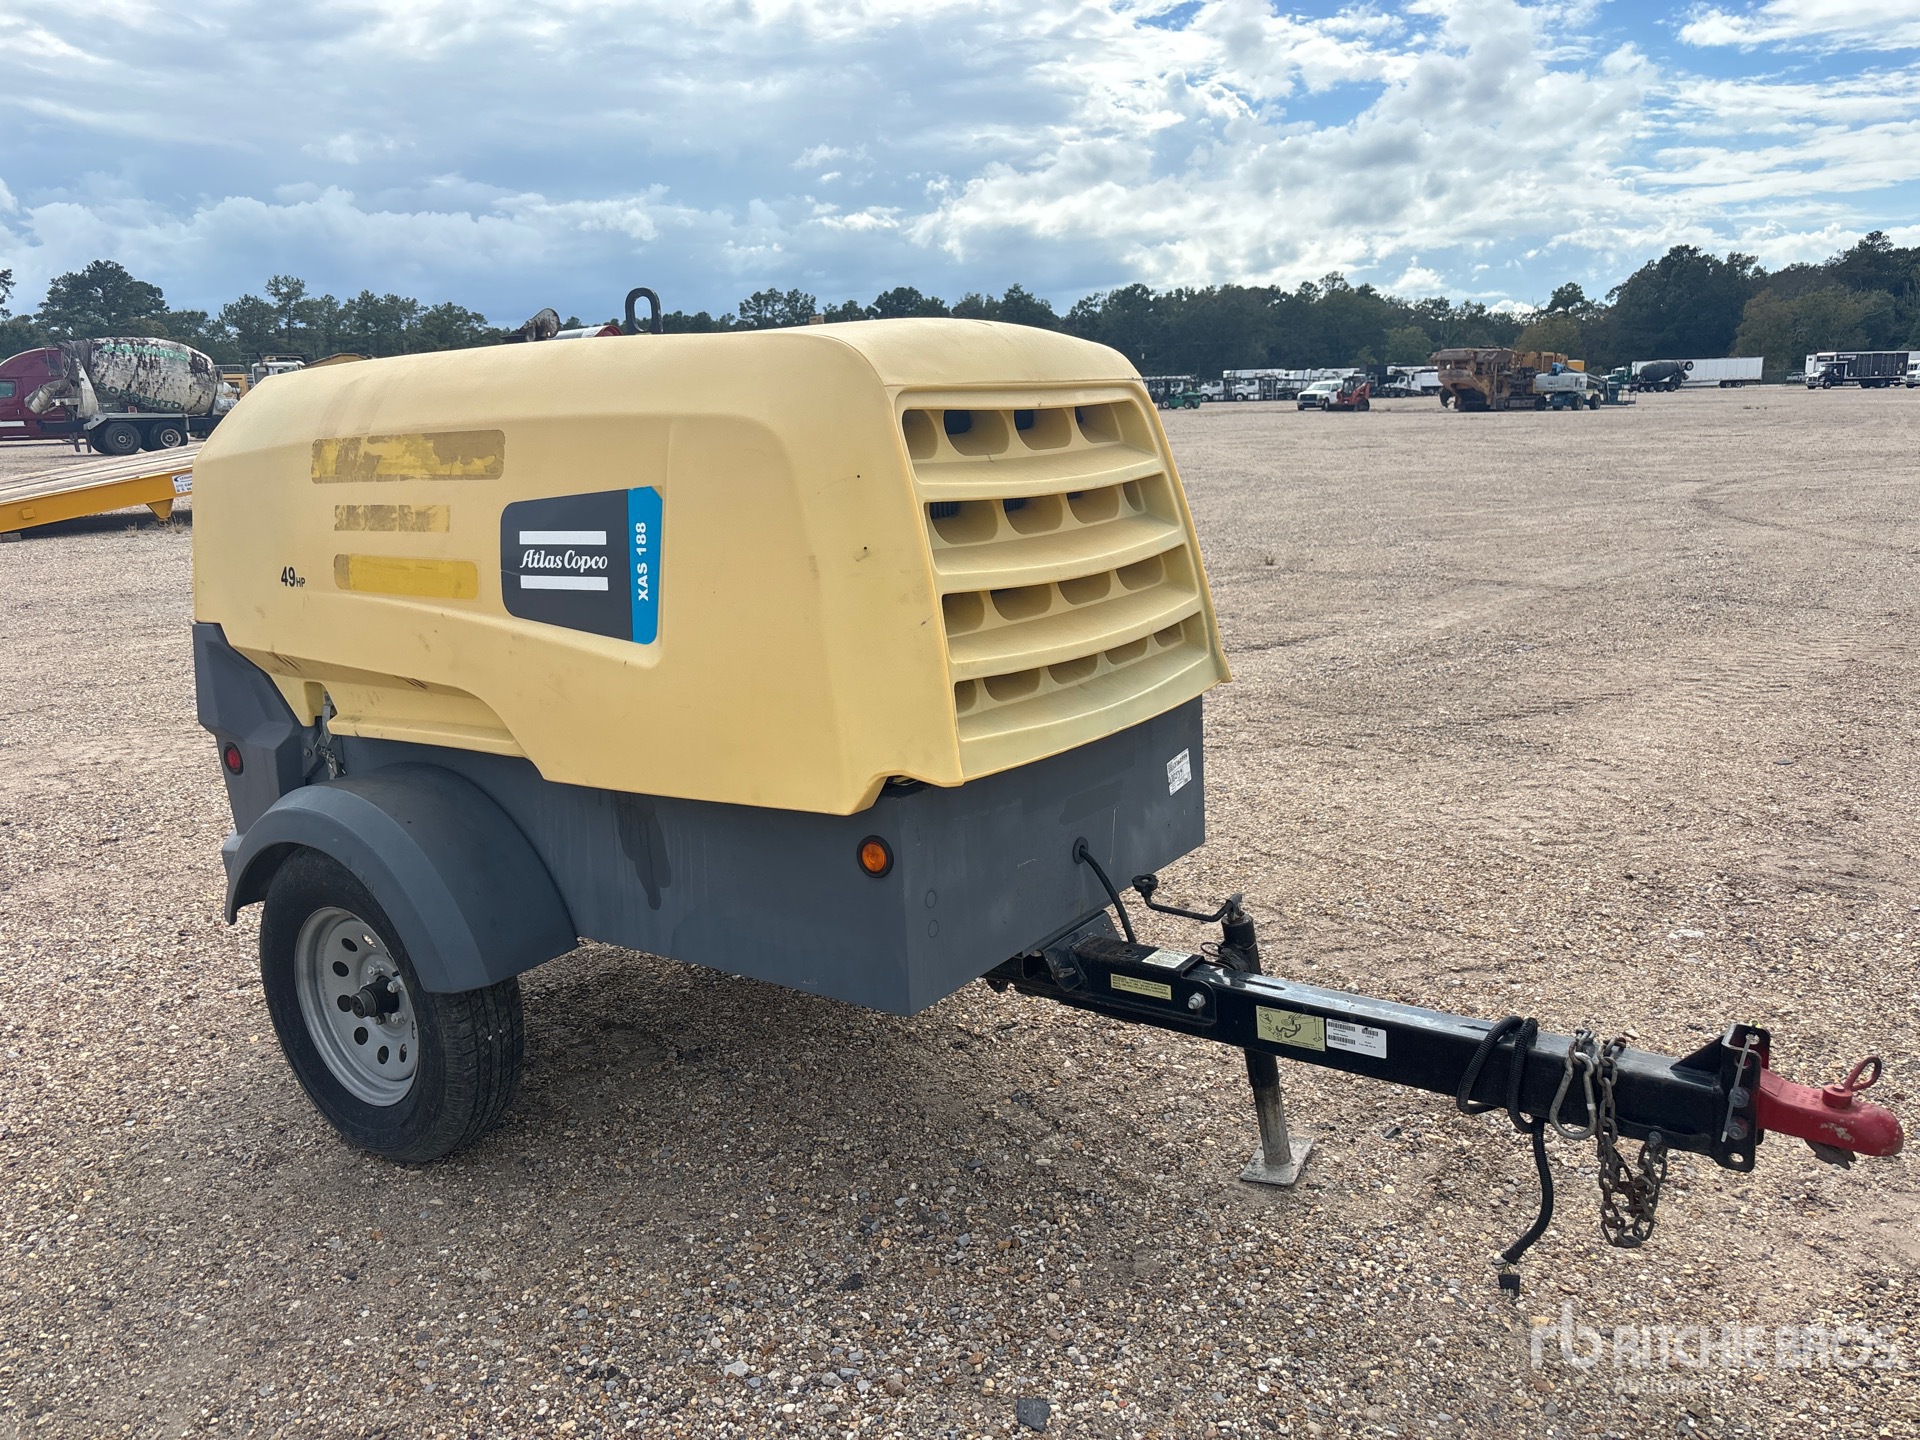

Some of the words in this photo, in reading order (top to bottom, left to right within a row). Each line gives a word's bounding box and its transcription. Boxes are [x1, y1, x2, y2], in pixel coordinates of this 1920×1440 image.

[635, 522, 647, 556] 188
[519, 549, 563, 569] Atlas
[563, 549, 608, 573] Copco
[637, 562, 649, 602] XAS
